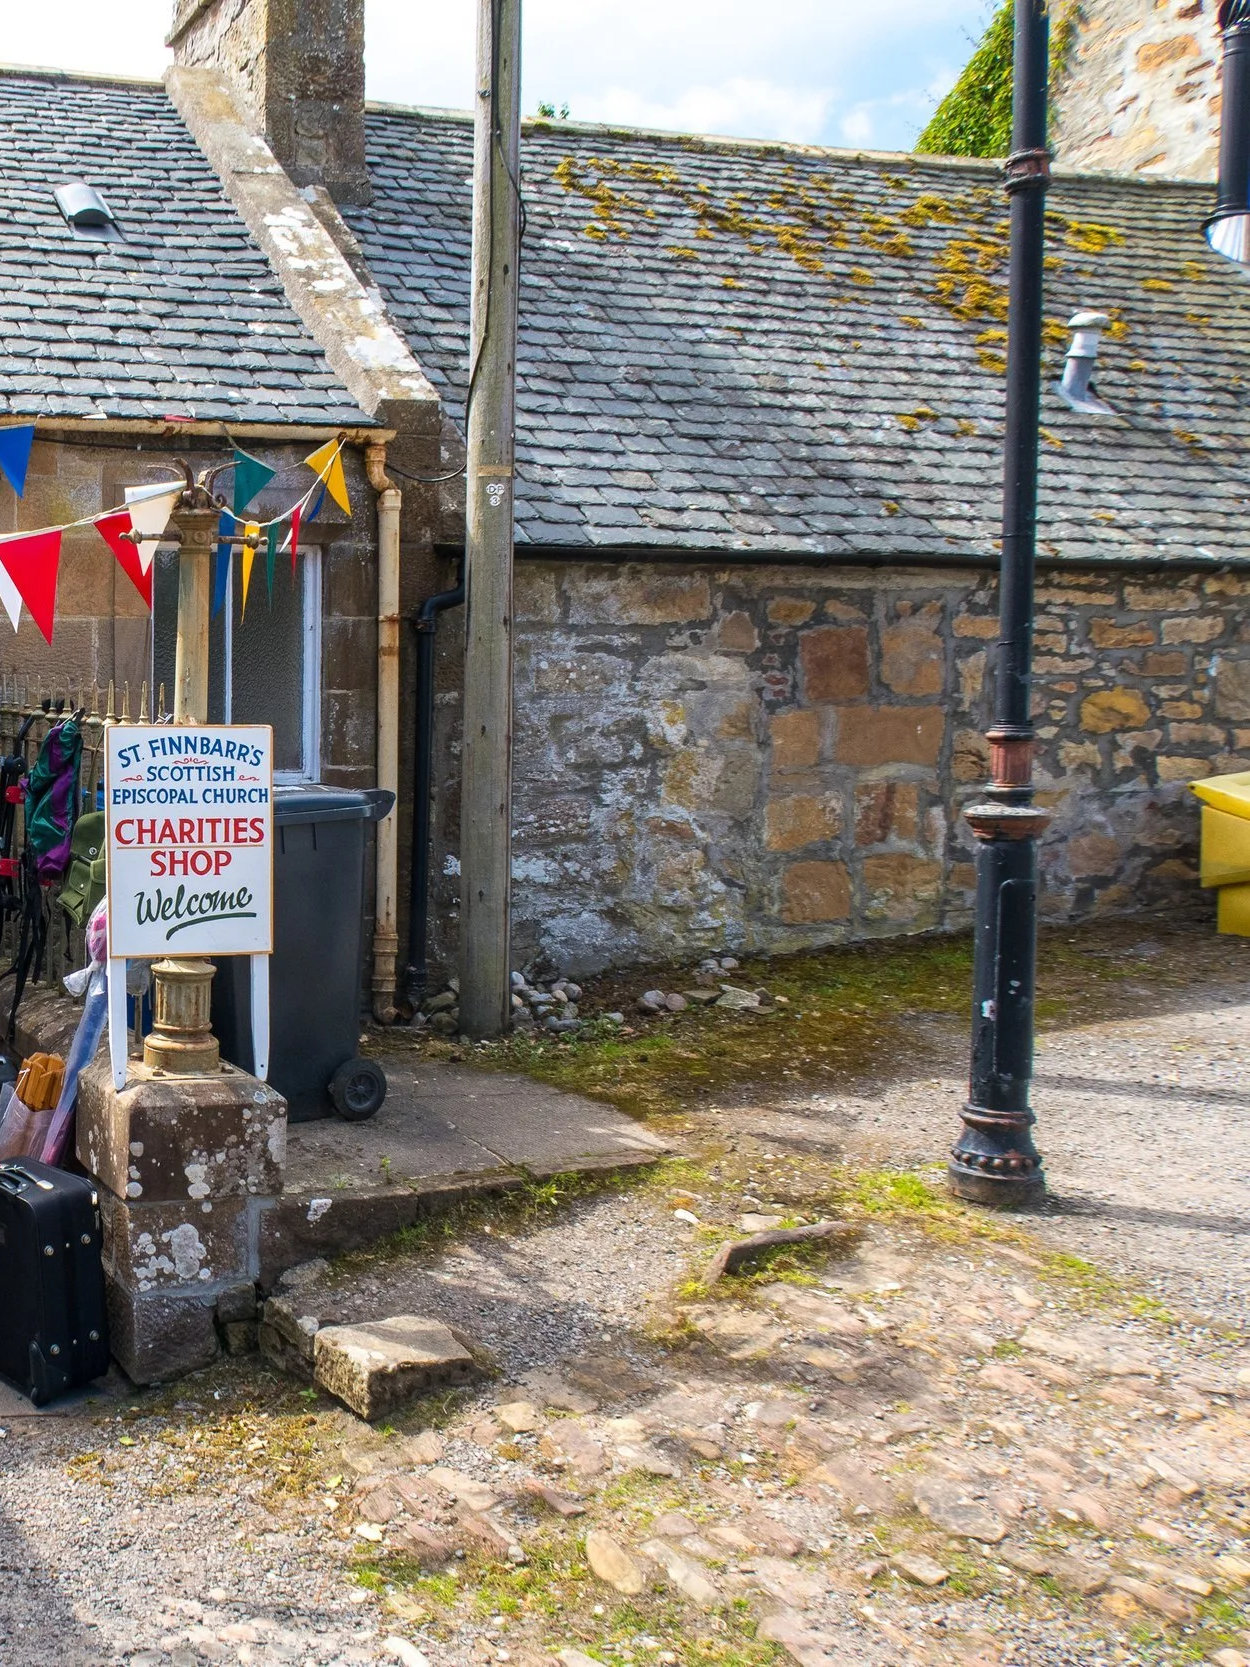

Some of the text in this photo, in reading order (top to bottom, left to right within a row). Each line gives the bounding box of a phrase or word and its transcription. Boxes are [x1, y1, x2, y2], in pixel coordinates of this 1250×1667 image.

[117, 736, 264, 768] ST. FINNBARR'S
[146, 766, 236, 782] SCOTTISH
[112, 788, 269, 804] EPISCOPAL CHURCH
[115, 818, 265, 845] CHARITIES
[150, 850, 232, 877] SHOP
[134, 884, 253, 926] Welcome
